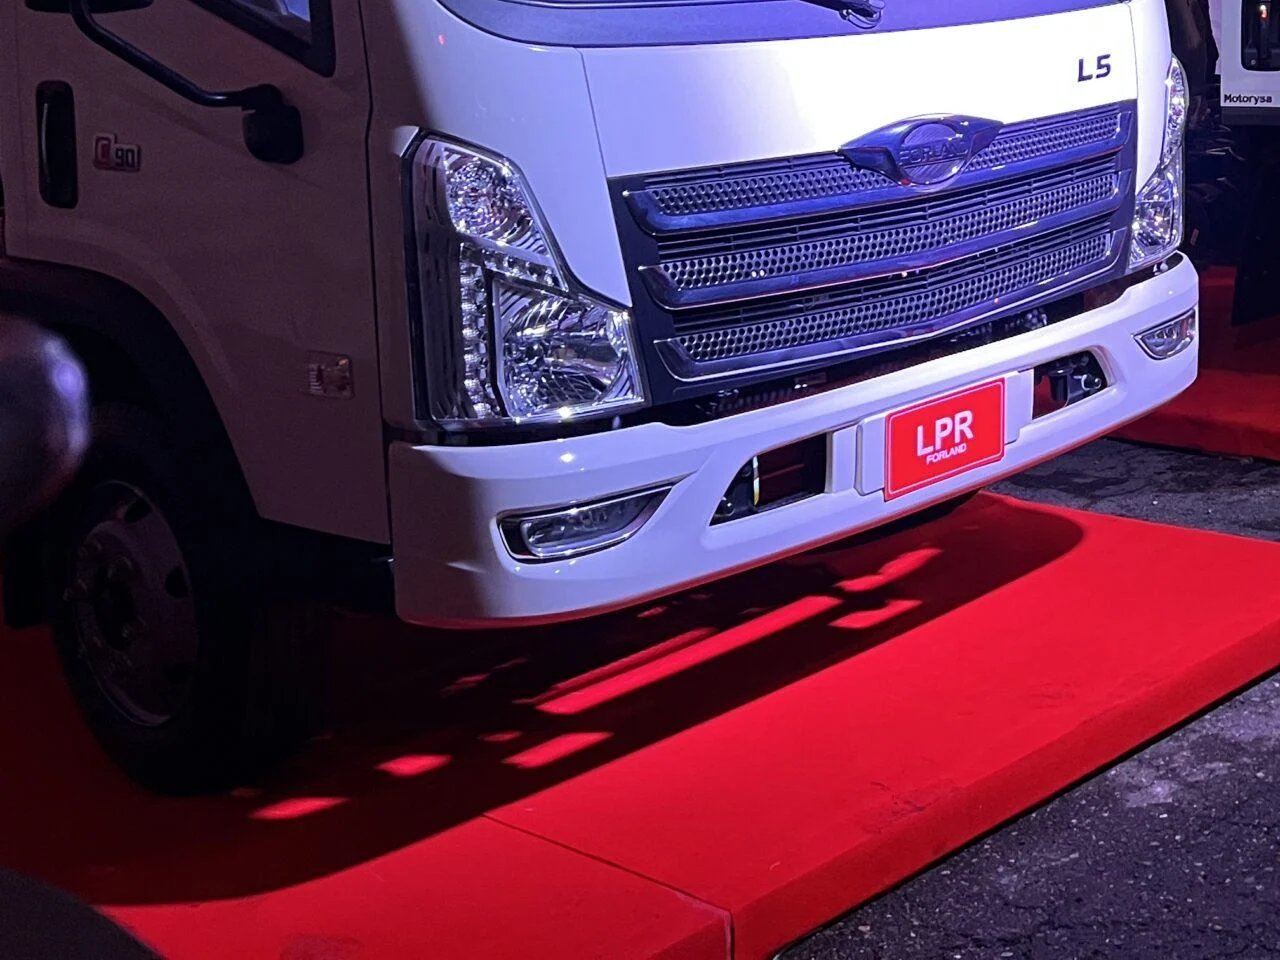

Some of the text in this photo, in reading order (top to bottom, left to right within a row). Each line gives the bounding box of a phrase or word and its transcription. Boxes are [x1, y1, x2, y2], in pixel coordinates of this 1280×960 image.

[1078, 54, 1112, 82] L5
[1223, 93, 1273, 105] Motorysa
[917, 410, 974, 457] LPR
[926, 443, 967, 465] FORLAND
